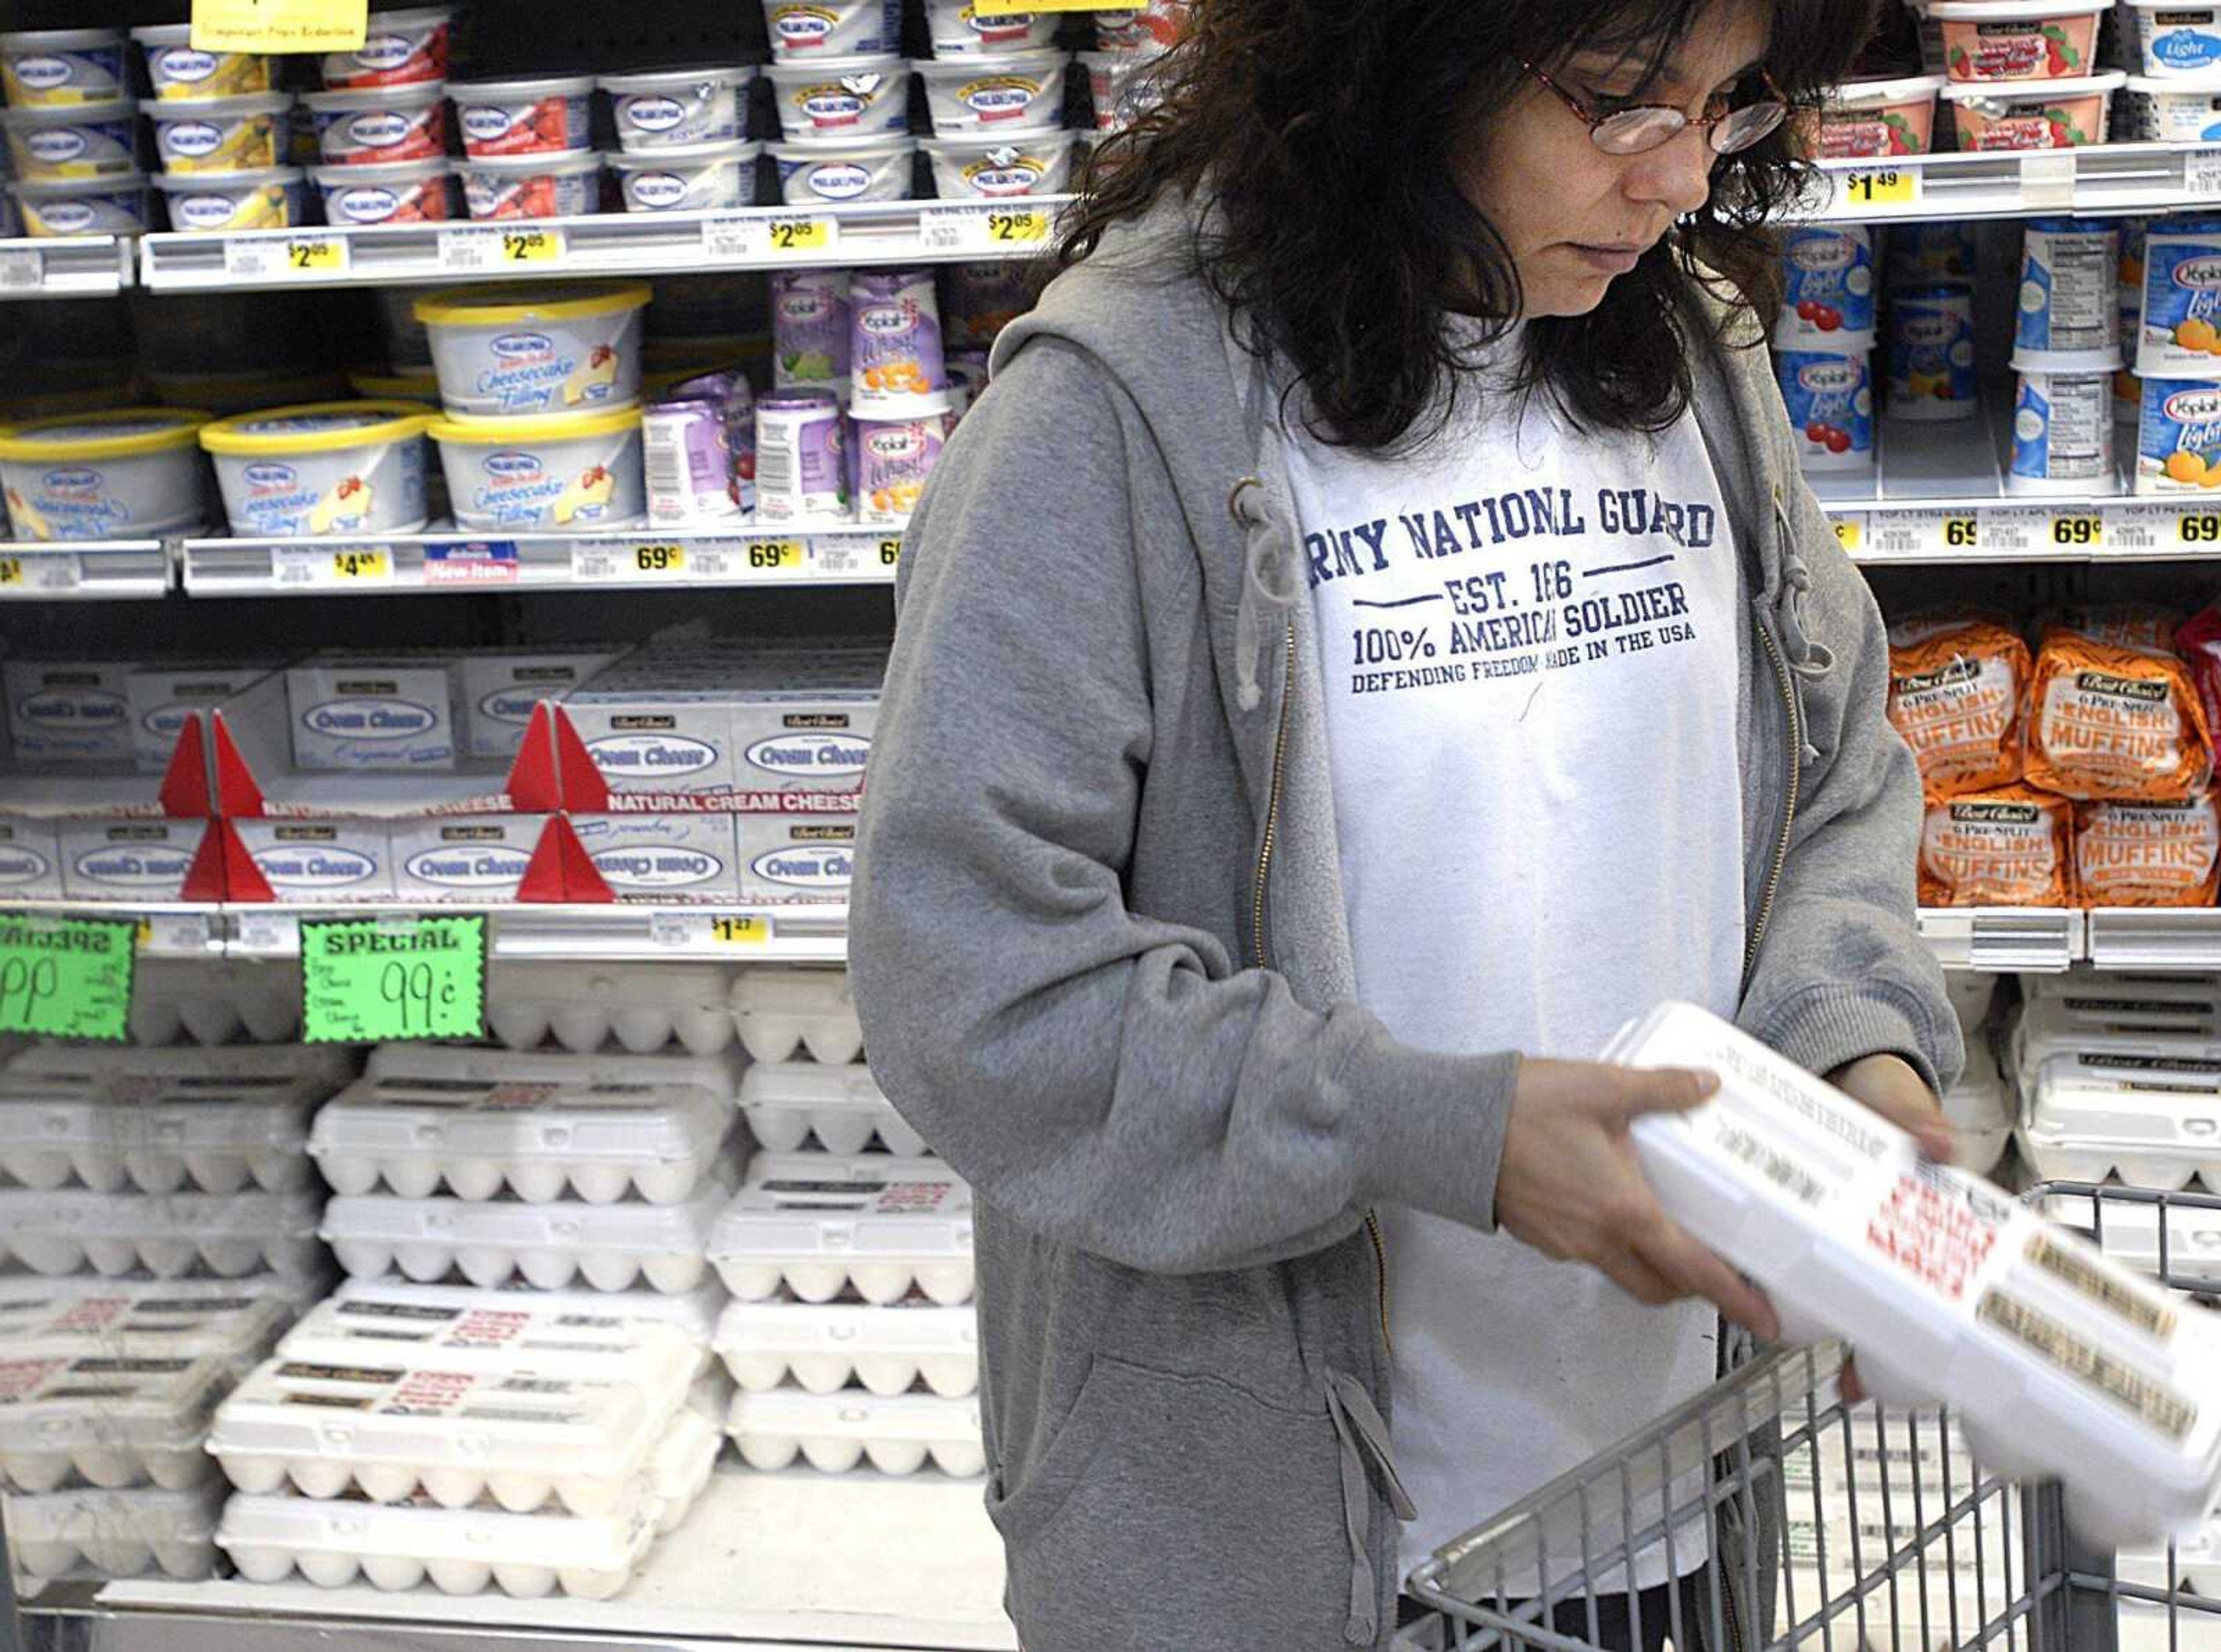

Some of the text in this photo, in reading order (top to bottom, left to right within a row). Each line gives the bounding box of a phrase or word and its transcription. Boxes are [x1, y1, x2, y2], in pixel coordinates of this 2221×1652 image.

[1304, 519, 1389, 589] RMY
[1444, 571, 1518, 615] EST.
[1353, 626, 1436, 665] 100%
[1563, 582, 1689, 637] SOLDIER
[1352, 664, 1466, 694] DEFENDING
[1585, 640, 1608, 661] IN
[1615, 630, 1654, 654] THE
[1658, 622, 1696, 645] USA
[2064, 702, 2167, 728] ENGLISH
[2051, 722, 2167, 757] MUFFINS
[608, 794, 703, 811] NATURAL
[704, 793, 780, 811] CREAM
[1942, 833, 2043, 851] ENGLISH
[2094, 821, 2200, 837] ENGLISH
[2083, 842, 2209, 868] MUFFINS
[326, 929, 458, 954] SPECIAL
